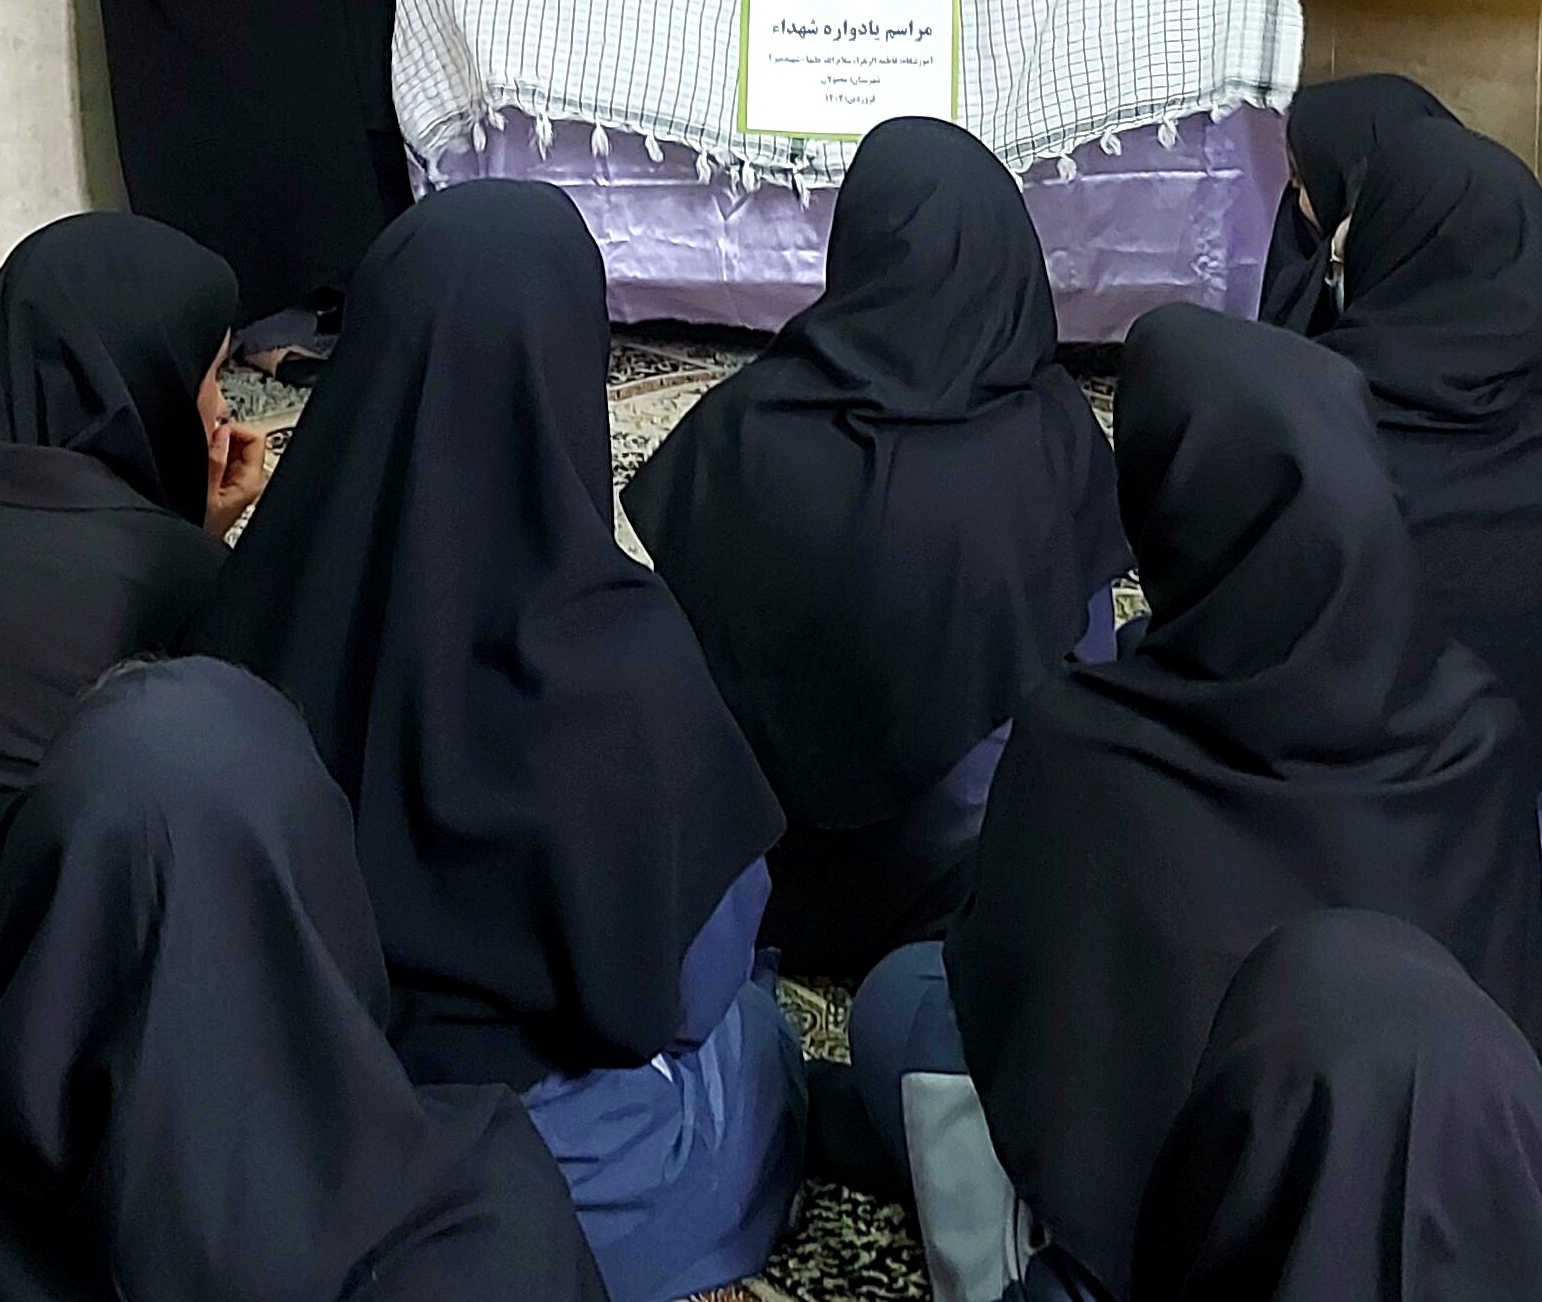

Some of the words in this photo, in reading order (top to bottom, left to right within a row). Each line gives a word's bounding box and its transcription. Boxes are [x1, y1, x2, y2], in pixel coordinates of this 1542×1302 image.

[771, 17, 820, 40] شهداء
[822, 18, 881, 42] یادواره
[884, 18, 933, 43] مراسم
